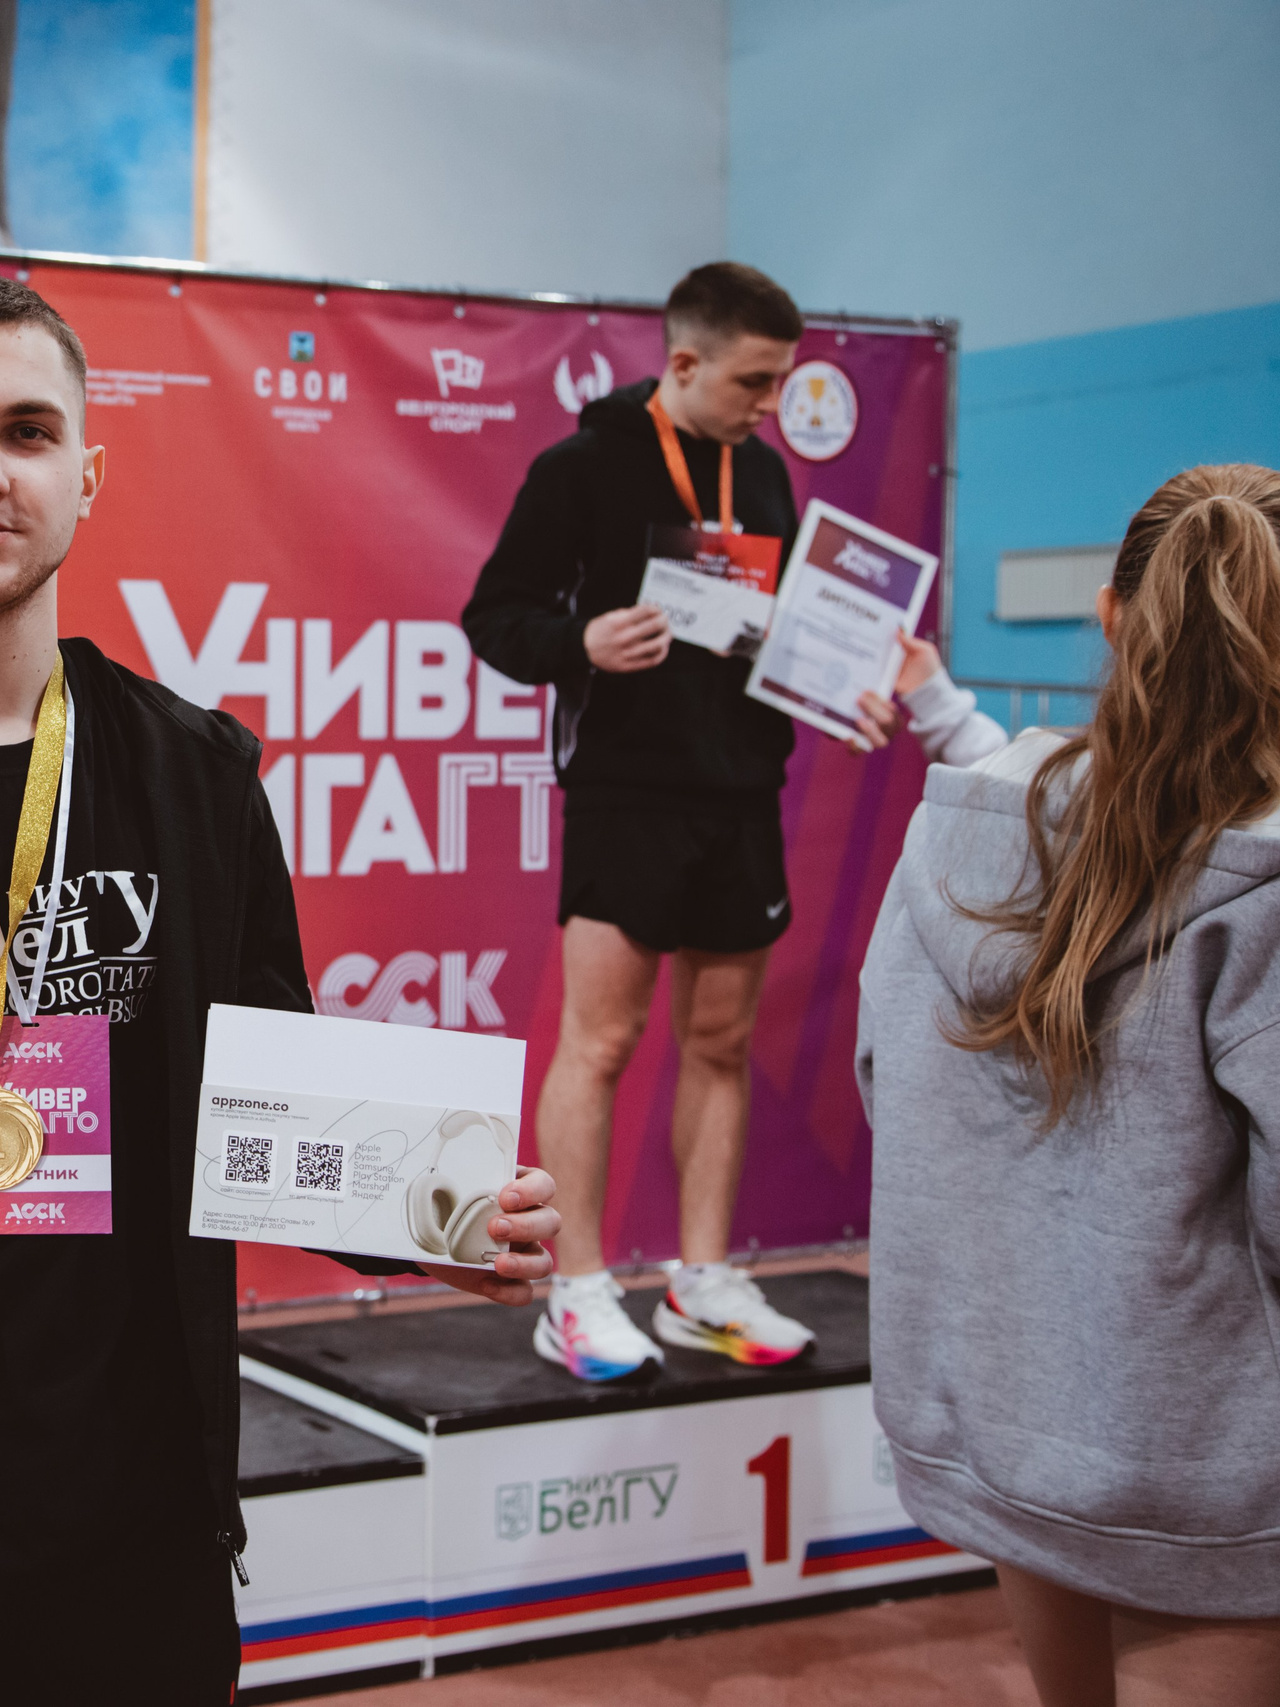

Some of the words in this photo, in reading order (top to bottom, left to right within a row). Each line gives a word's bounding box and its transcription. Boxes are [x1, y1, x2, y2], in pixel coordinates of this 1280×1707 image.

[254, 366, 348, 402] СВОИ
[315, 949, 508, 1028] ССК
[211, 1096, 289, 1111] appzone.co
[355, 1142, 381, 1153] Apple
[354, 1151, 381, 1161] Dyson
[353, 1161, 394, 1174] Samsung
[353, 1171, 371, 1181] Play
[374, 1172, 404, 1183] Station
[352, 1180, 390, 1191] Marshall
[351, 1189, 384, 1200] Яндекс
[5, 1202, 66, 1219] АССК
[202, 1210, 222, 1218] Адрес
[249, 1214, 279, 1223] Проспект
[538, 1473, 678, 1535] БелГУ
[747, 1435, 791, 1565] 1
